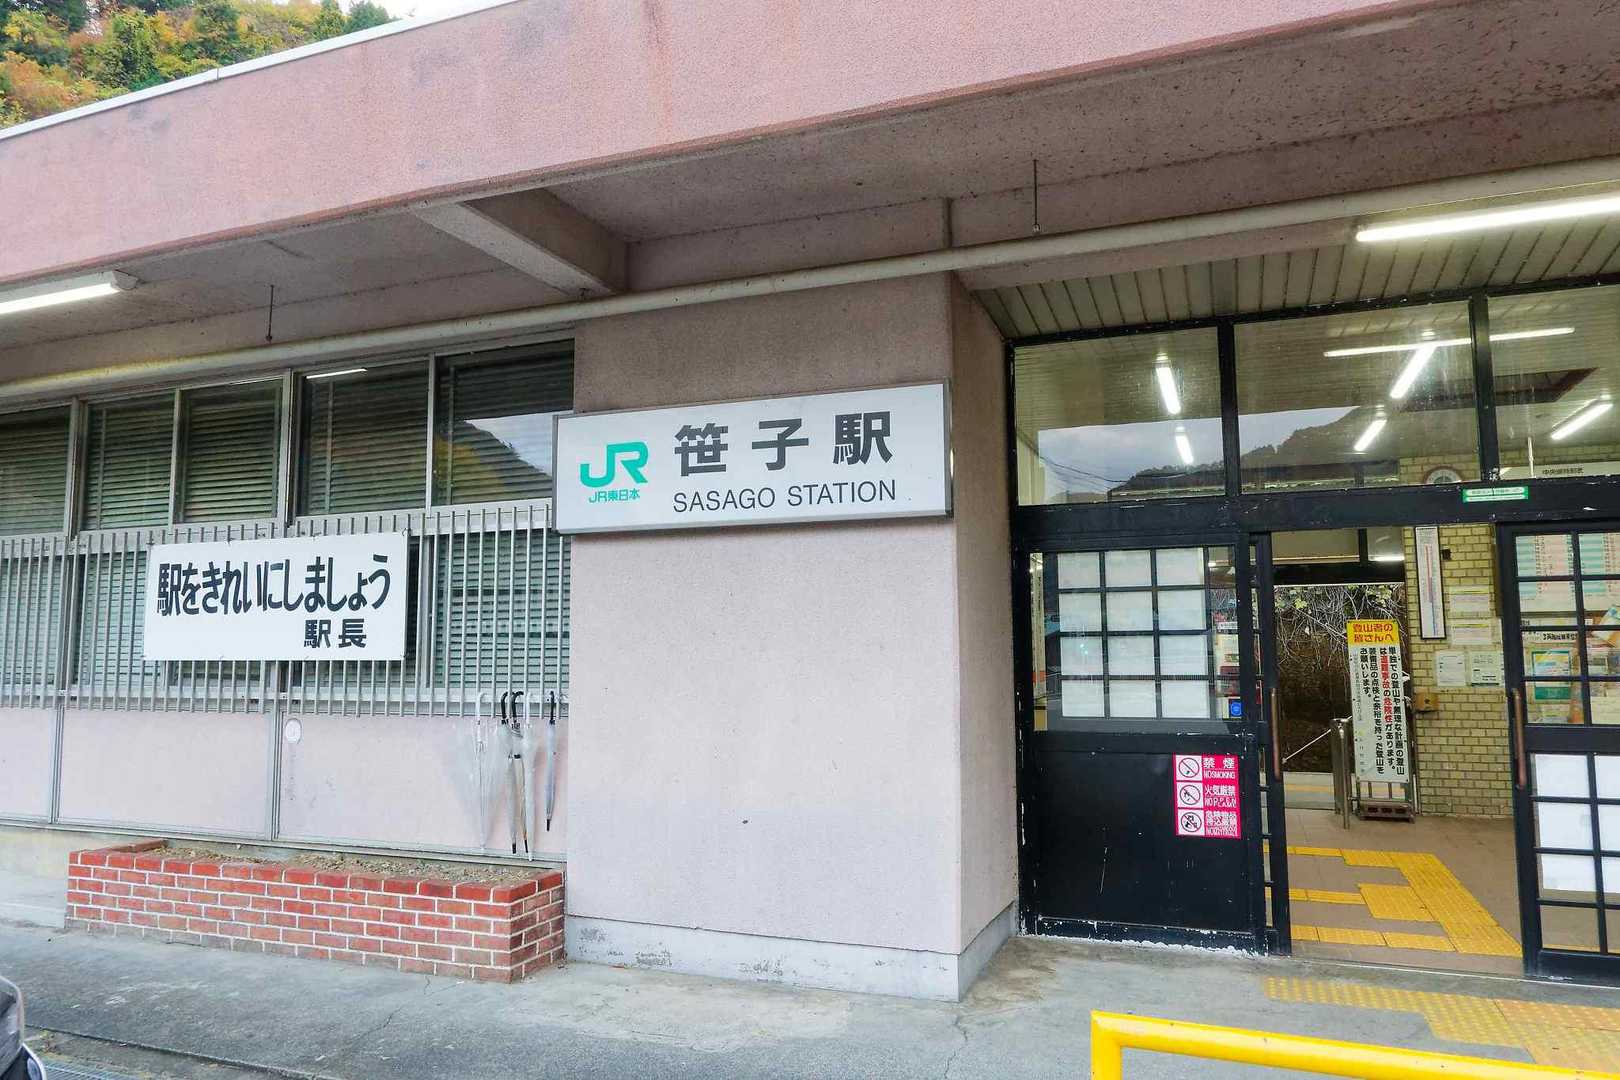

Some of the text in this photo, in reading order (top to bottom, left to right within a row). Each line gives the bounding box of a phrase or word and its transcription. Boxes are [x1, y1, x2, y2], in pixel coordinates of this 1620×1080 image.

[674, 411, 893, 477] 笹子駅
[579, 441, 648, 488] JR
[588, 488, 641, 503] JR東日本
[673, 480, 897, 513] SASAGO STATION
[157, 554, 391, 617] 駅をきれいにしましょう
[303, 618, 367, 649] 駅長
[1203, 757, 1235, 769] 禁煙
